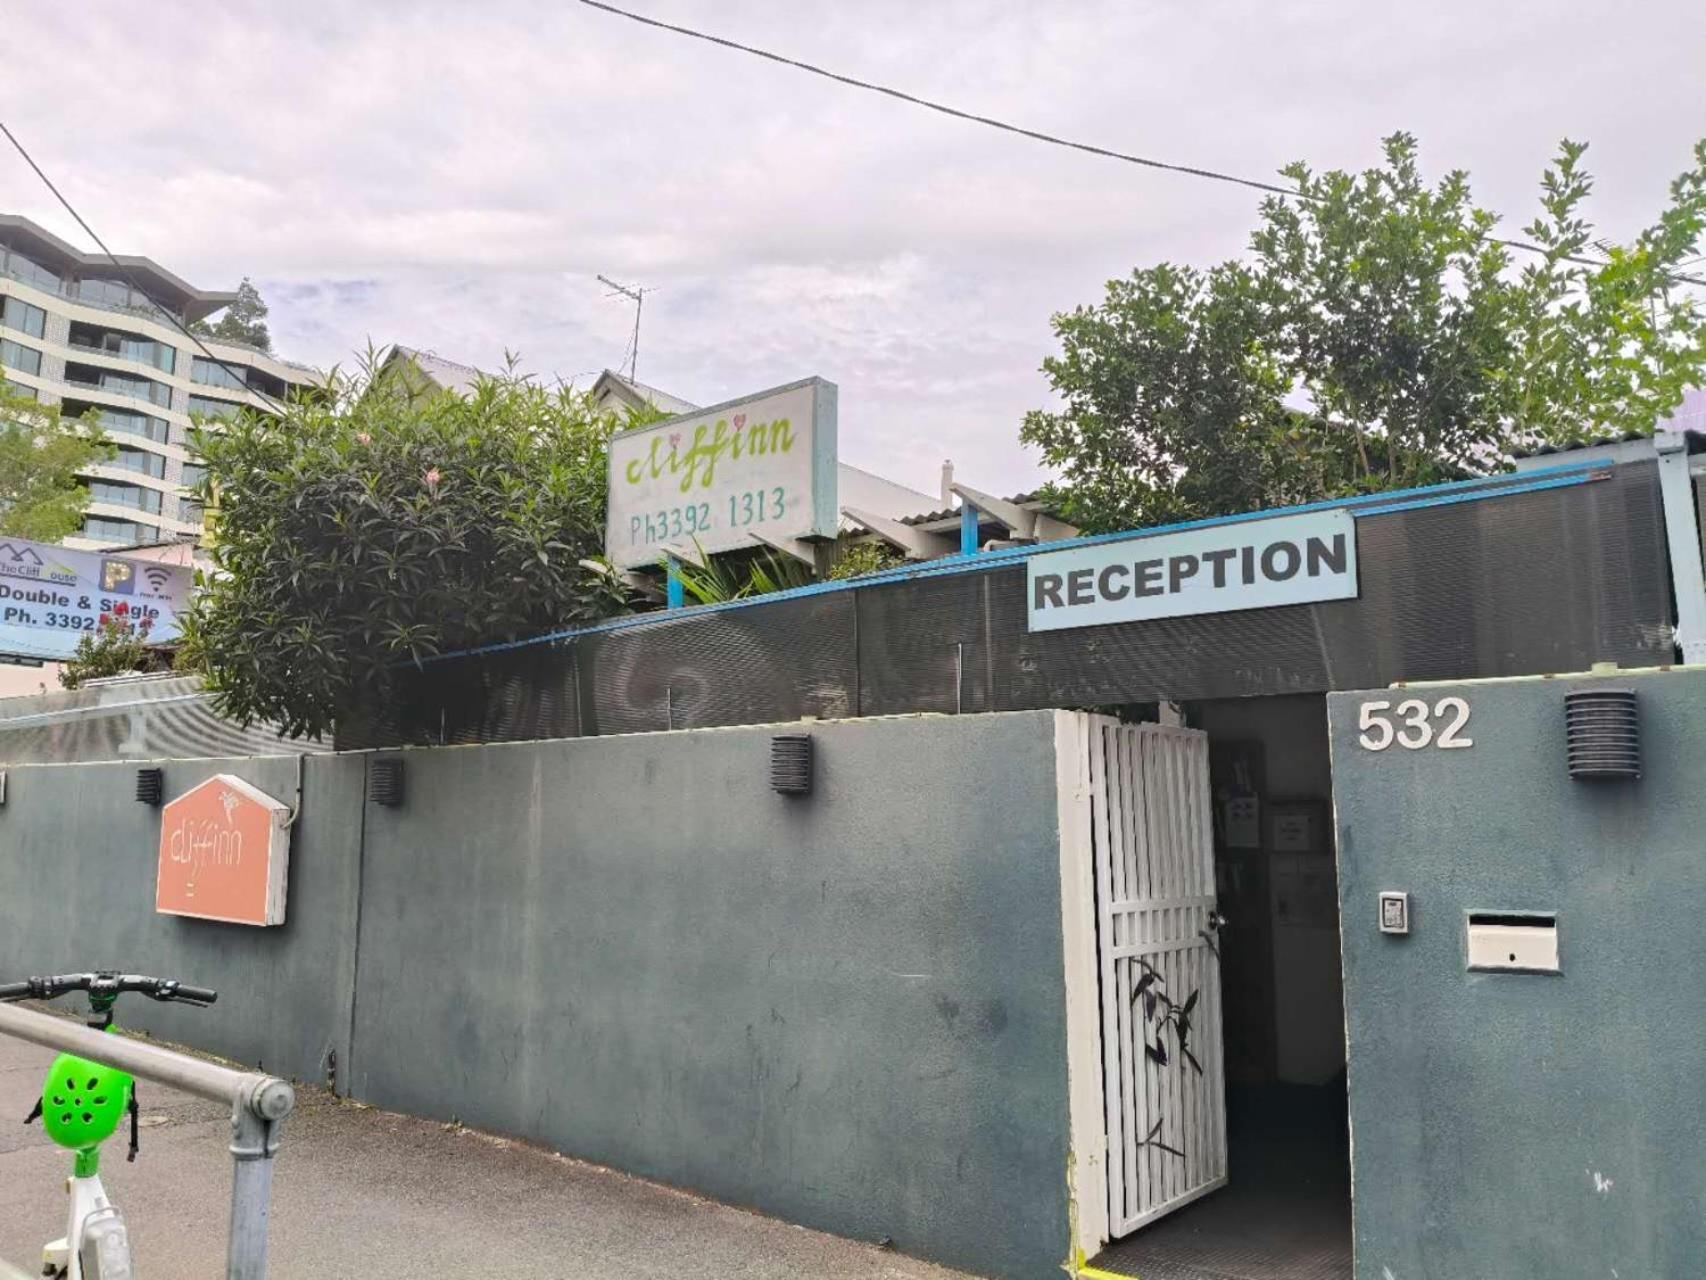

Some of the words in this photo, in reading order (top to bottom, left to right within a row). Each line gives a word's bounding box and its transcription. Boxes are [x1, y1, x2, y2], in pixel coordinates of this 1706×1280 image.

[729, 487, 785, 528] 1313
[1034, 533, 1347, 610] RECEPTION
[0, 585, 70, 607] Double
[77, 595, 92, 609] &
[100, 598, 160, 619] Sigle
[4, 607, 37, 624] Ph.
[45, 612, 95, 630] 3392
[1359, 697, 1473, 750] 532
